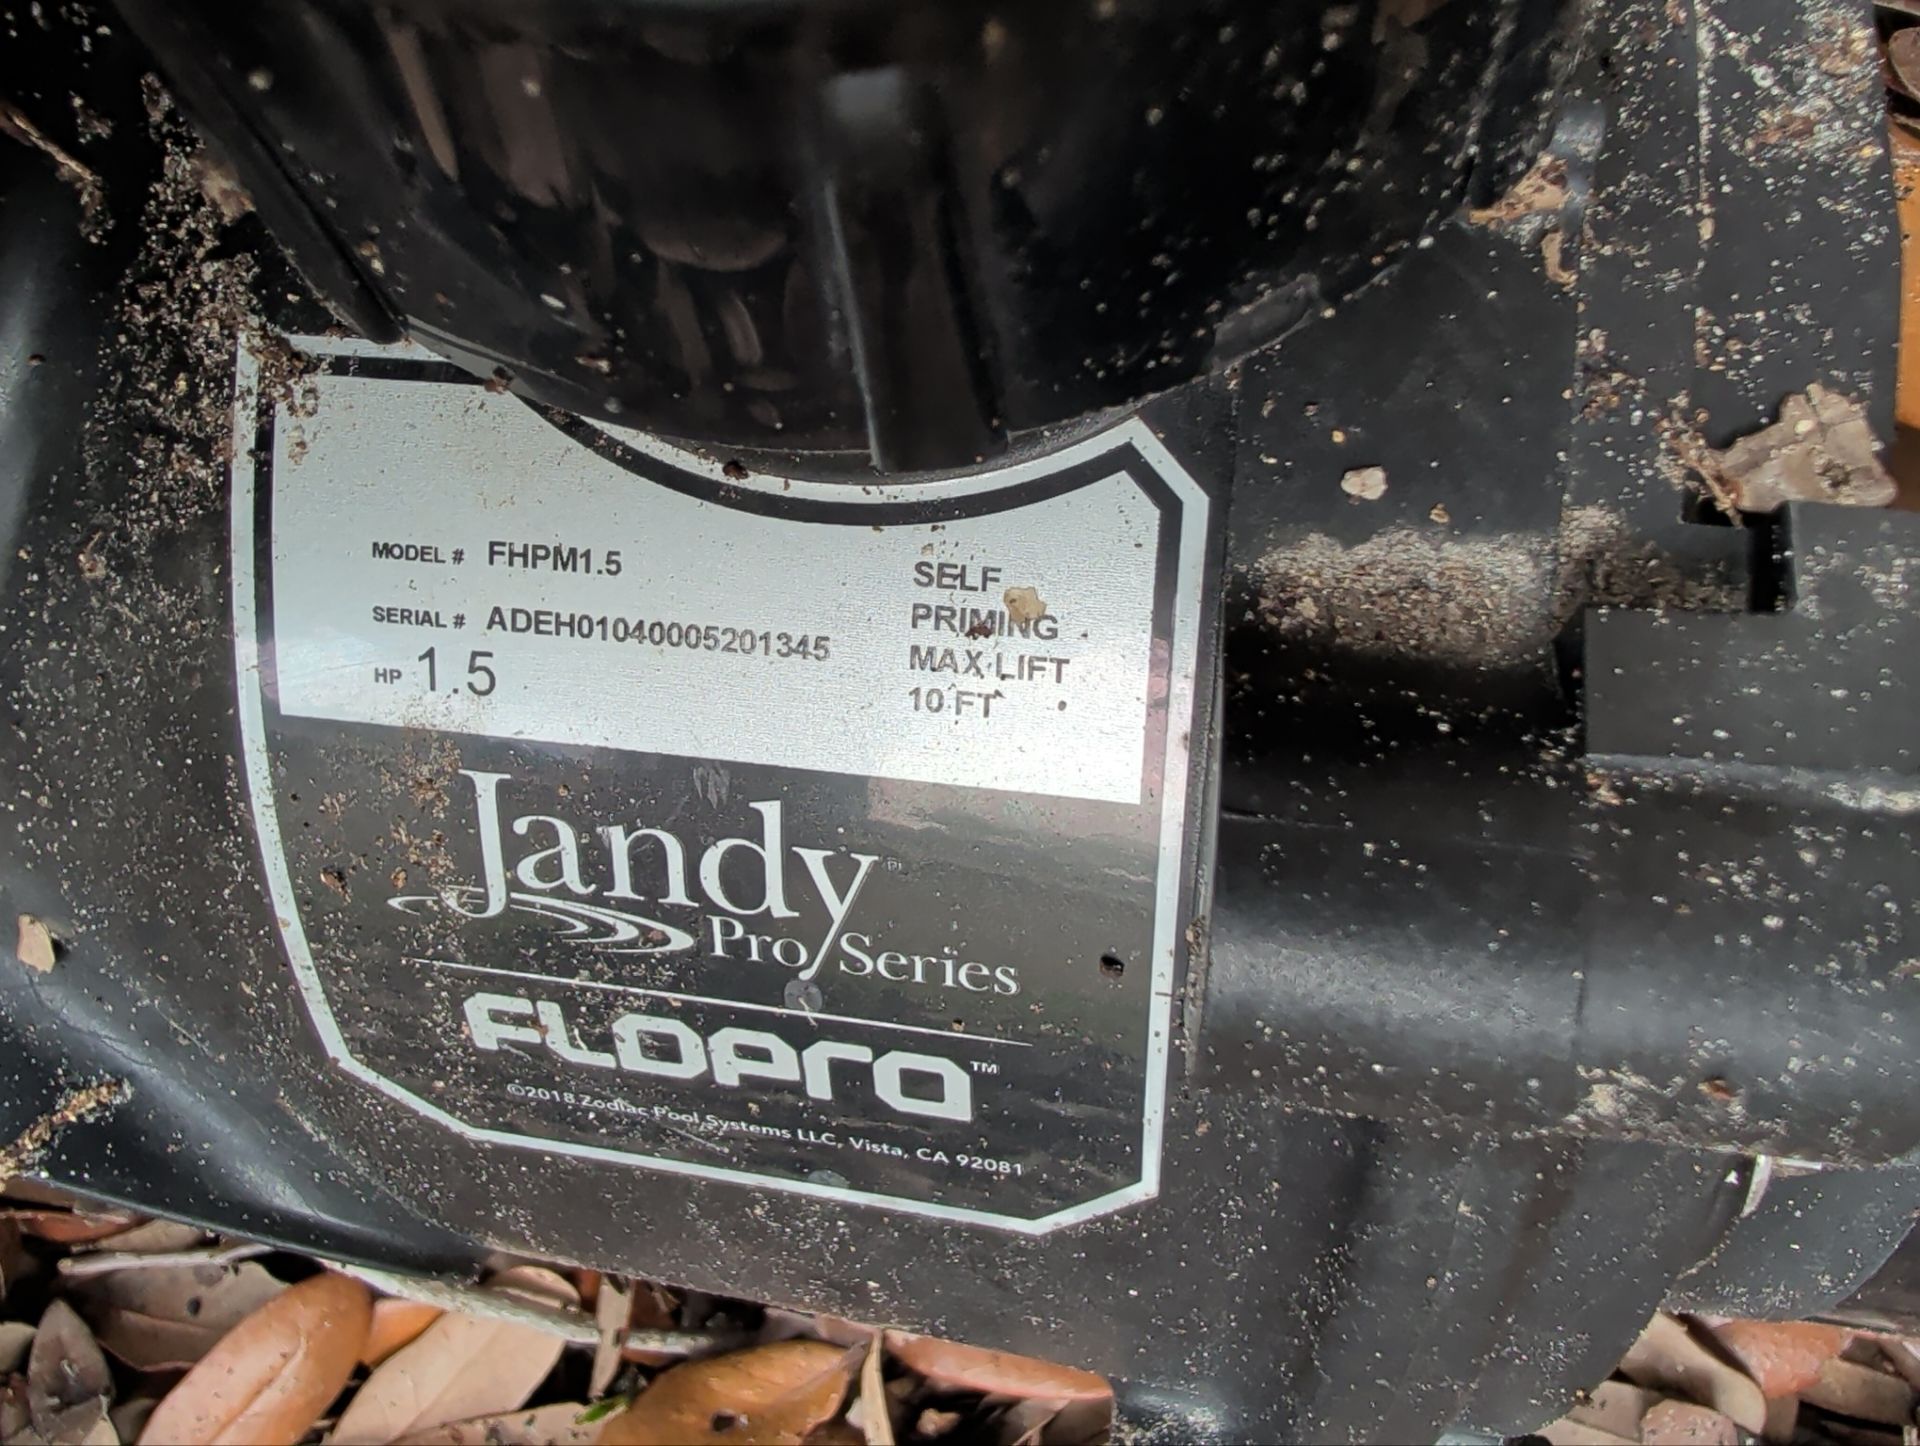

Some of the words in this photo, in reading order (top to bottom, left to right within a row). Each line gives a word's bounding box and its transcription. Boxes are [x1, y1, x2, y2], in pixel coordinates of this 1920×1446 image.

[372, 541, 446, 564] MODEL
[452, 547, 465, 566] #
[487, 540, 622, 577] FHPM1.5
[913, 560, 1002, 592] SELF
[372, 605, 447, 629] SERIAL
[453, 612, 467, 630] #
[487, 605, 831, 662] ADEH01040005201345
[911, 602, 1059, 641] PRIMING
[374, 667, 402, 686] HP
[418, 646, 497, 697] 1.5
[909, 644, 984, 679] MAX
[995, 651, 1071, 684] LIFT
[908, 686, 945, 714] 10
[955, 689, 1003, 719] FT
[457, 768, 879, 982] Jandy
[707, 914, 808, 967] Pro
[839, 930, 1020, 997] Series
[653, 1105, 700, 1125] Pool
[704, 1114, 792, 1139] Systems
[797, 1127, 844, 1149] LLC,
[849, 1136, 910, 1160] Vista,
[916, 1148, 950, 1166] CA
[955, 1153, 1023, 1176] 92081
